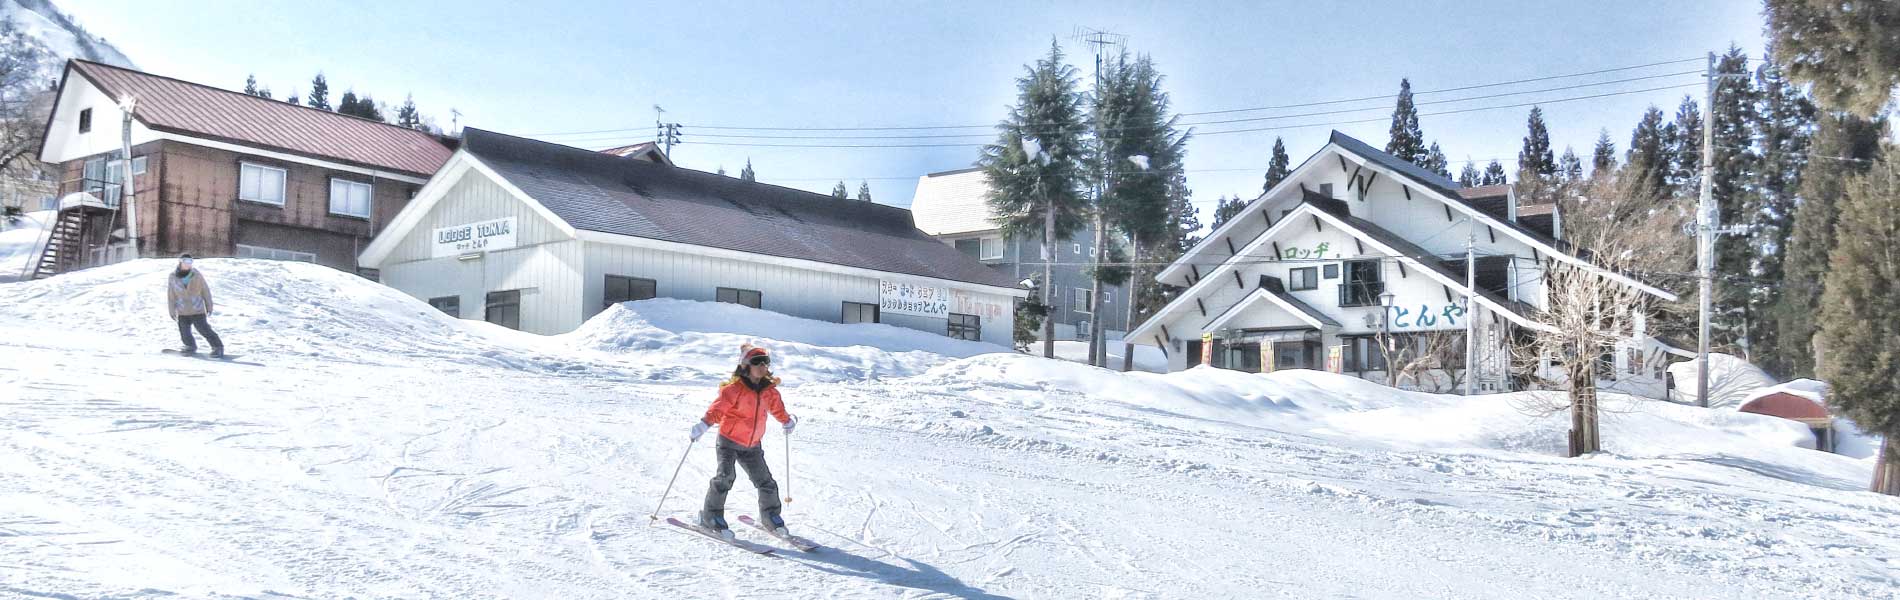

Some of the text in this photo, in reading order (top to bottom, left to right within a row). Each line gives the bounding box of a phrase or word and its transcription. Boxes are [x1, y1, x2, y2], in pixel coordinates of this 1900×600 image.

[439, 220, 510, 243] LODGE TONYA
[1282, 241, 1329, 259] ロッヂ
[881, 281, 897, 295] スキー
[1393, 303, 1464, 328] とんや
